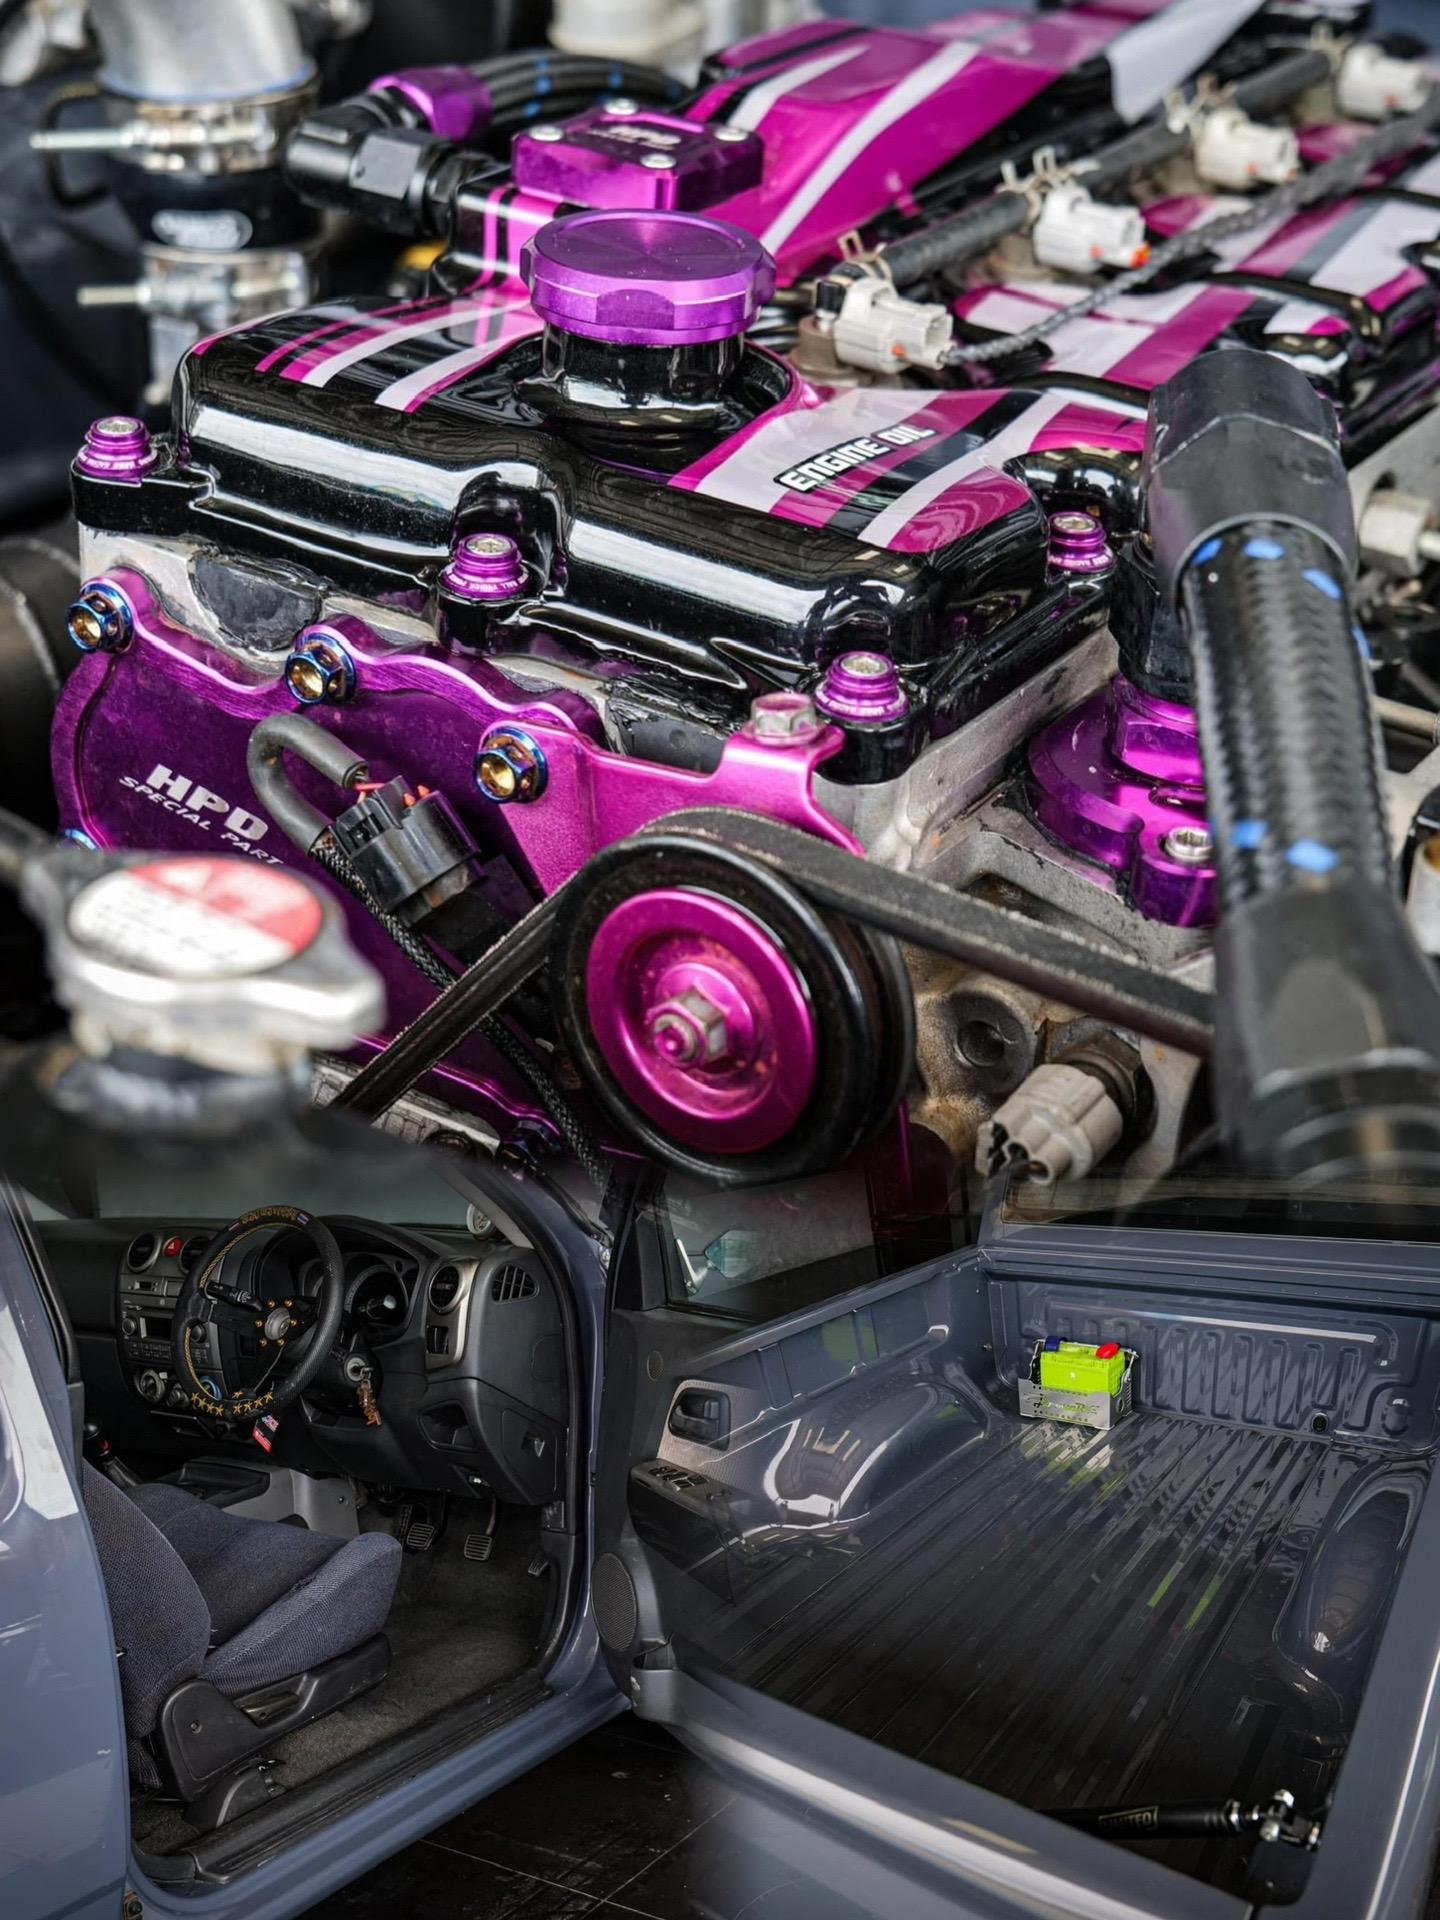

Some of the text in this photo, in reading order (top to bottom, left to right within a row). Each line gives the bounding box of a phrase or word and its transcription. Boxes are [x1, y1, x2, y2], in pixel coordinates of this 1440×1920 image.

[780, 425, 936, 492] ENGINE OIL
[119, 776, 212, 831] SPECIAL
[146, 763, 269, 841] HPD
